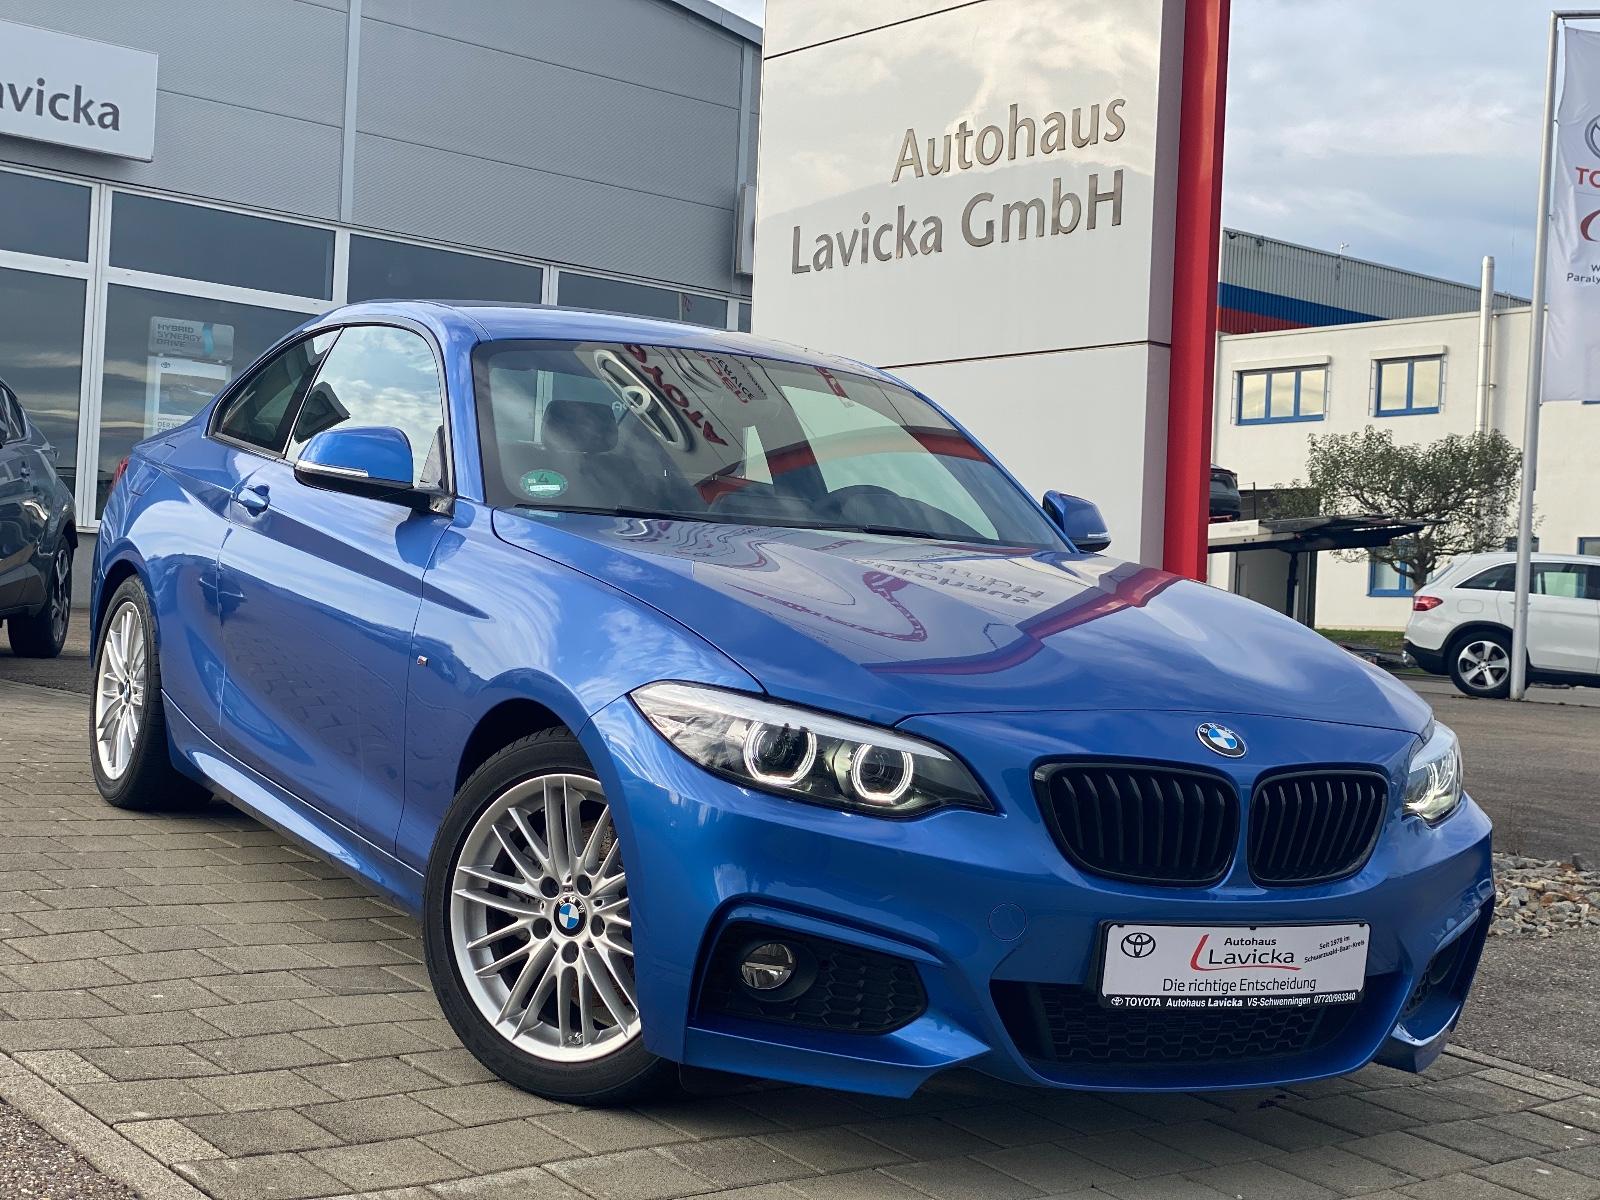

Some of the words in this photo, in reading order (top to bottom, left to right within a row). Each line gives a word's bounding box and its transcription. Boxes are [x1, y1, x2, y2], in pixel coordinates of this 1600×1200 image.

[0, 77, 120, 132] vicka
[891, 98, 1126, 183] Autohaus
[791, 205, 943, 275] Lavicka
[961, 169, 1124, 248] GmbH
[157, 324, 194, 334] HYBRID
[157, 331, 202, 342] SYNERGY
[156, 338, 186, 348] DRIVE
[1224, 937, 1277, 946] Autohaus
[1319, 942, 1330, 950] Seit
[1208, 948, 1295, 965] Lavicka
[1162, 978, 1185, 992] Die
[1188, 978, 1237, 995] richtige
[1239, 977, 1317, 992] Entscheidung
[1125, 997, 1161, 1007] TOYOTA
[1166, 997, 1206, 1008] Autohaus
[1207, 997, 1243, 1007] Lavicka
[1247, 996, 1311, 1008] VS-Schwenningen
[1313, 992, 1356, 1004] 07720/993340
